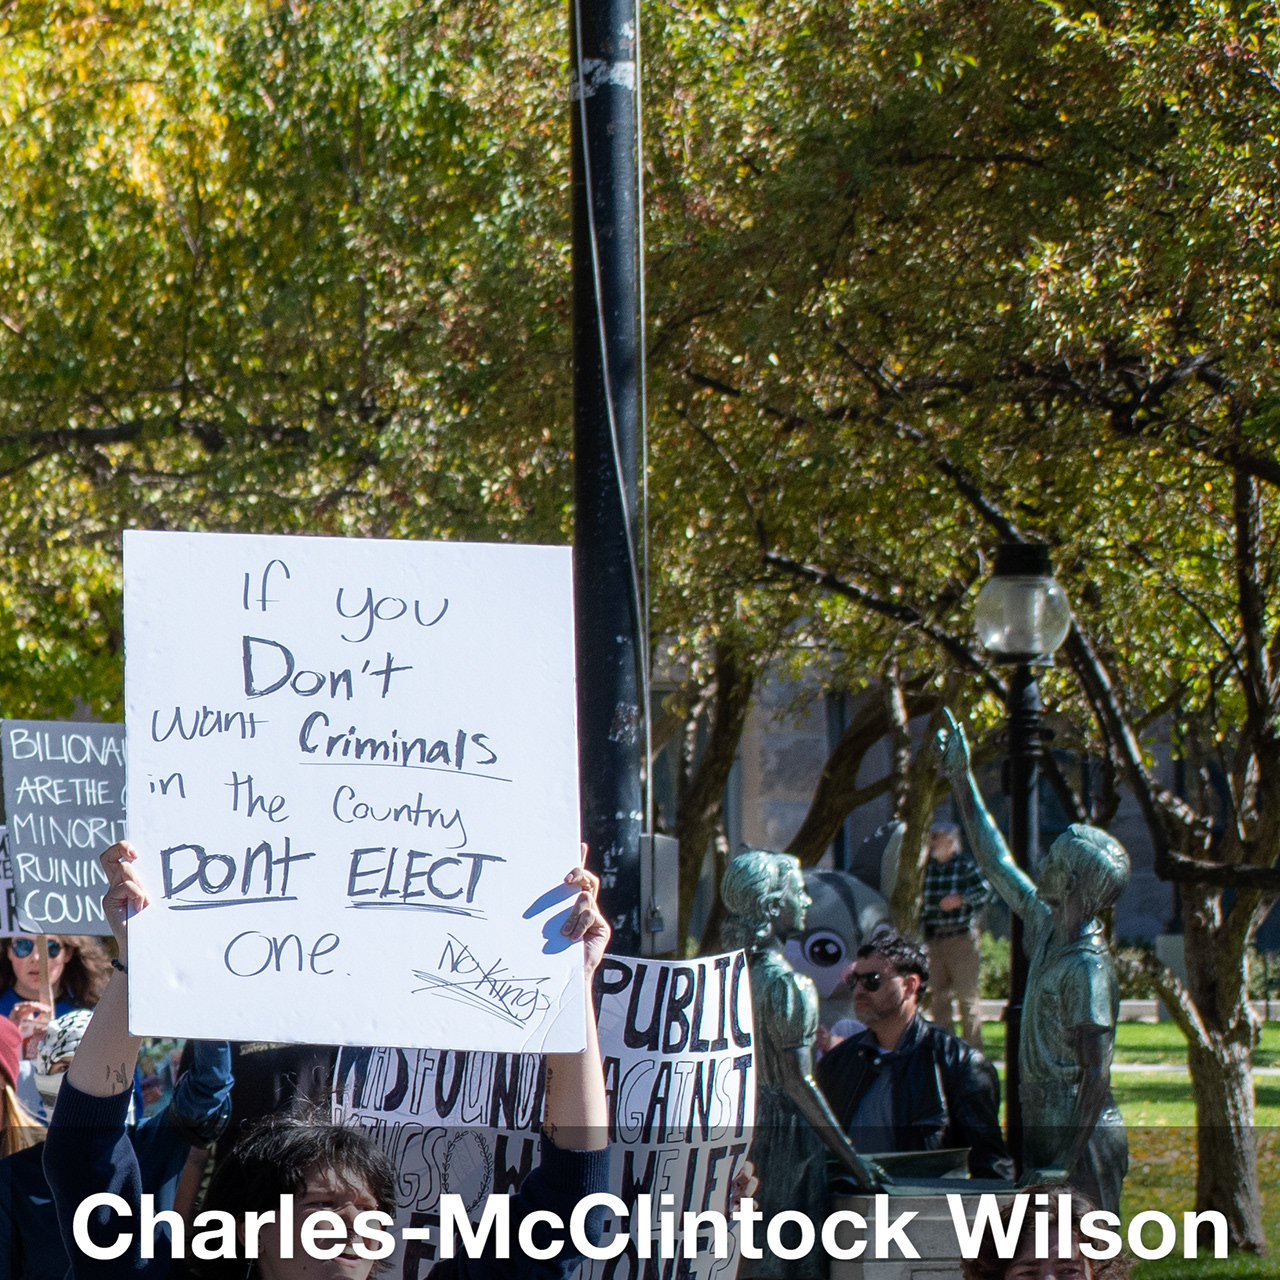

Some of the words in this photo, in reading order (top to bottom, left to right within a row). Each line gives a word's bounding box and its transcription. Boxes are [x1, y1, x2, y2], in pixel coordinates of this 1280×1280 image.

[242, 559, 290, 612] If
[335, 586, 450, 643] you
[241, 635, 414, 700] Don't
[16, 776, 72, 805] ARE
[68, 778, 114, 806] THE
[147, 772, 186, 799] in
[224, 771, 290, 823] the
[13, 813, 127, 849] MINORIT
[16, 853, 110, 888] RUININ
[346, 847, 508, 903] ELECT
[24, 889, 105, 923] COUN
[602, 1053, 753, 1146] AGAINST
